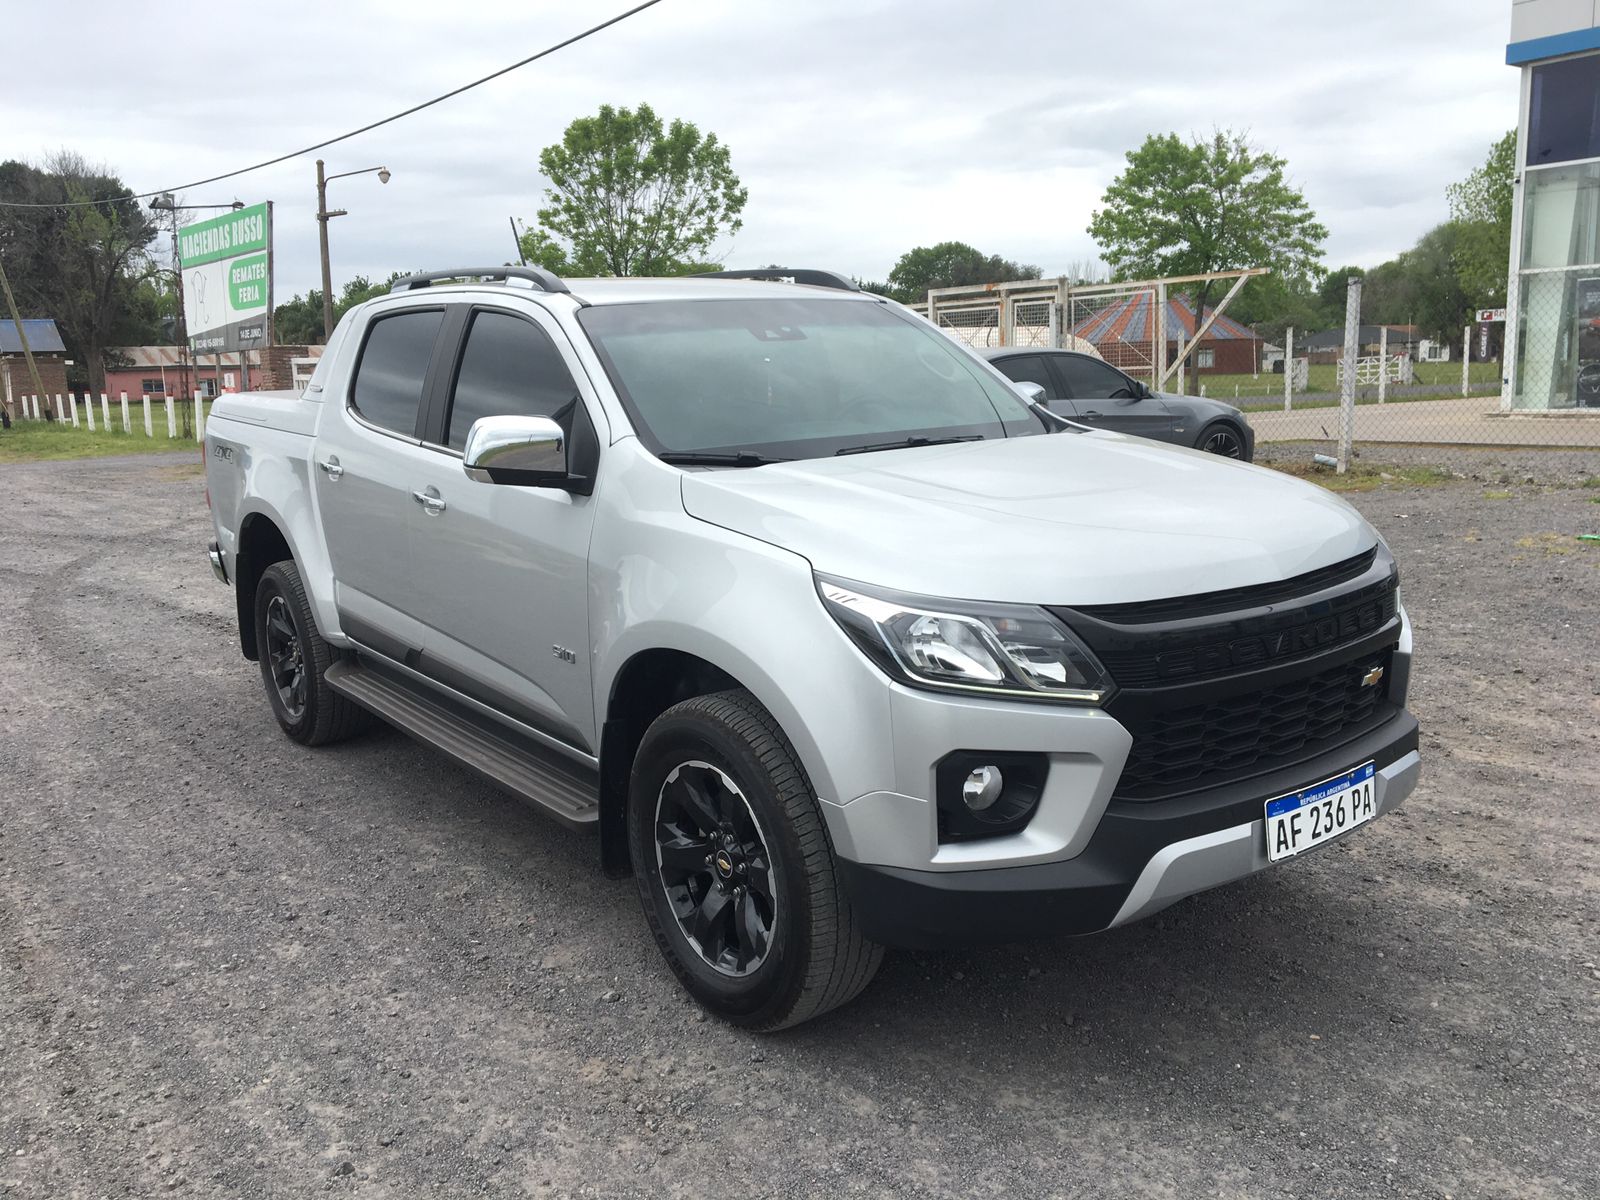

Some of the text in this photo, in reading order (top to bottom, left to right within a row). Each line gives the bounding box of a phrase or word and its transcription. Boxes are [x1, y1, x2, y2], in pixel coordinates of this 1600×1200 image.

[182, 214, 263, 259] HACIENDAS RUSSO
[232, 262, 265, 284] REMATES
[238, 284, 259, 304] FERIA
[1326, 781, 1351, 797] ARGENTINA
[1276, 783, 1371, 853] AF 236 PA
